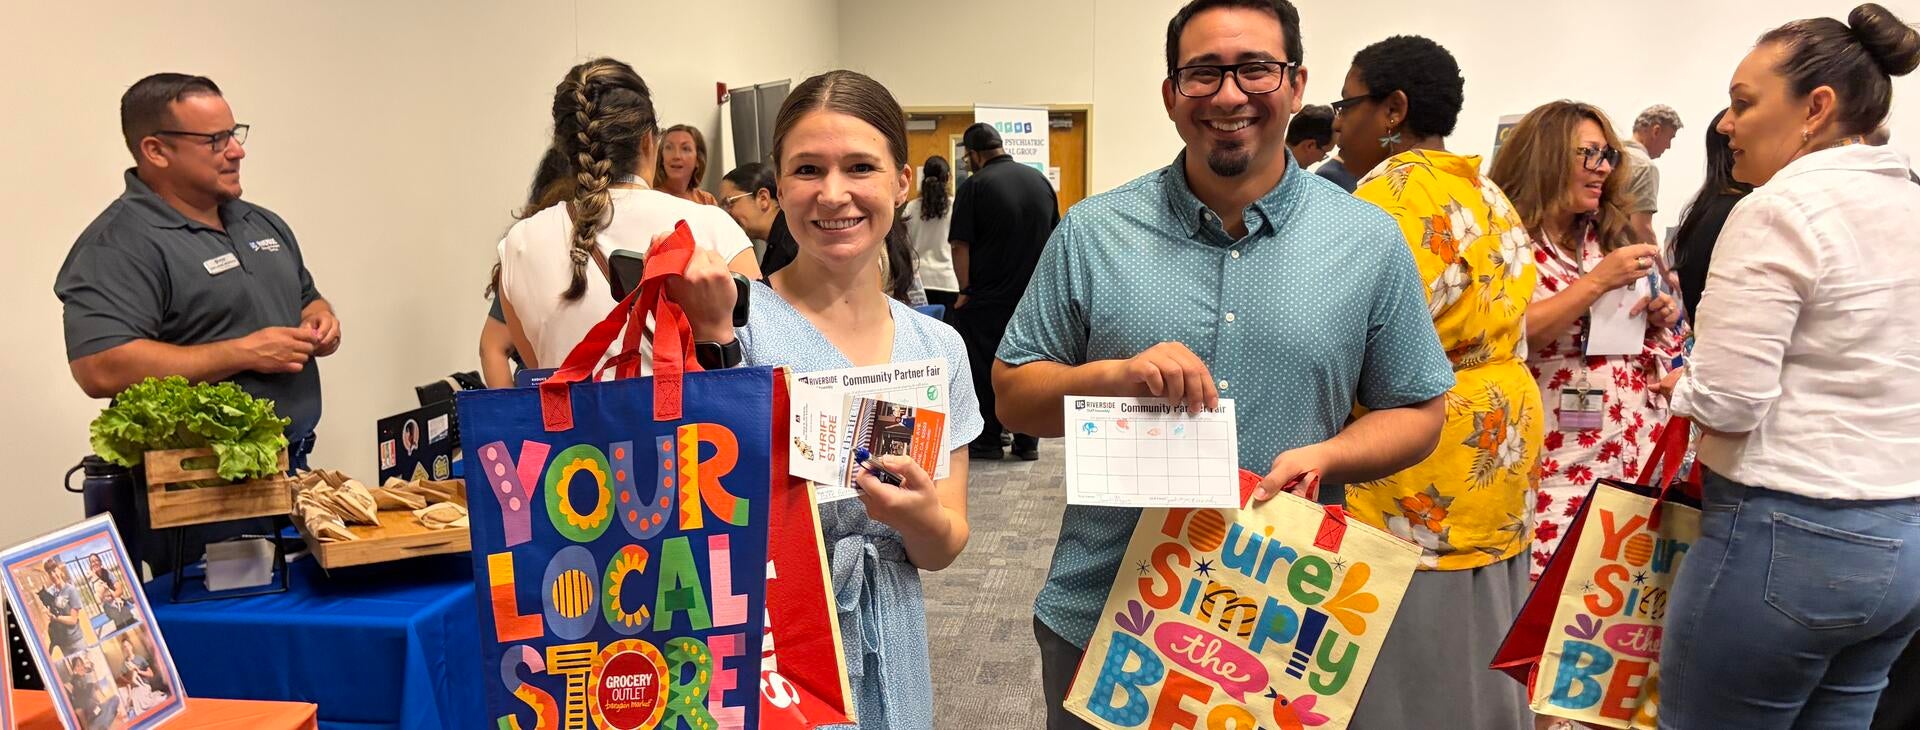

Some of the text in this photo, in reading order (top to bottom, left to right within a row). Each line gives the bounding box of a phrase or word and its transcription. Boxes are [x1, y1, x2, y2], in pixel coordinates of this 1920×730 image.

[1004, 138, 1045, 146] PSYCHIATRIC
[1016, 147, 1038, 155] GROUP
[809, 375, 838, 385] RIVERSIDE
[842, 372, 892, 387] Community
[894, 369, 924, 380] Partner
[926, 365, 941, 376] Fair
[1086, 401, 1116, 409] RIVERSIDE
[1120, 402, 1171, 415] Community
[1174, 403, 1209, 413] Parer
[819, 410, 828, 460] THRIFT
[828, 414, 838, 462] STORE
[477, 423, 750, 548] YOUR
[487, 533, 749, 643] LOCAL
[1138, 542, 1360, 696] Simply
[1170, 634, 1251, 683] the
[497, 632, 747, 730] STORE
[606, 673, 653, 689] GROCERY
[612, 687, 646, 701] OUTLET
[605, 698, 653, 713] bargain market
